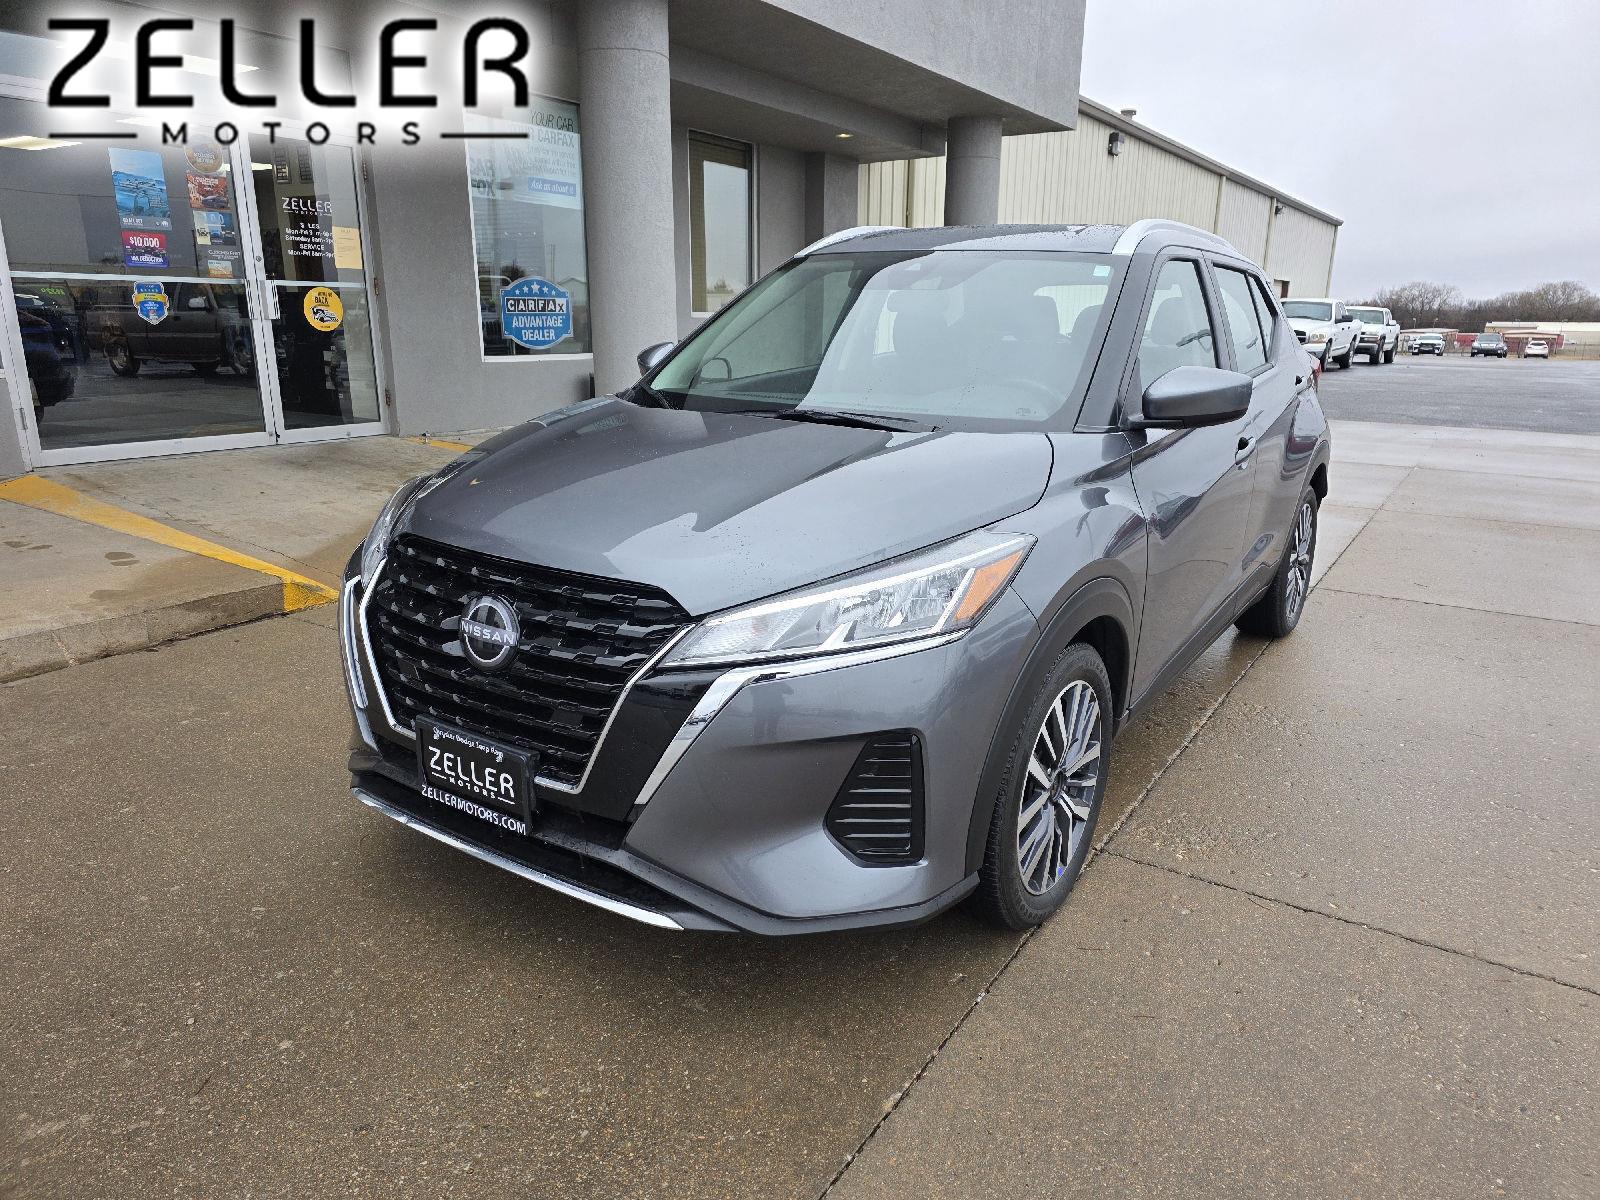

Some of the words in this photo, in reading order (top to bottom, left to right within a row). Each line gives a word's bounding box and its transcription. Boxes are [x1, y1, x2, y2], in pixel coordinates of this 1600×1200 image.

[556, 115, 574, 134] CAR
[537, 127, 575, 148] CARFAX
[281, 196, 333, 213] ZELLER
[299, 222, 320, 230] SLES
[129, 236, 160, 248] $10,000
[299, 243, 325, 251] SERVICE
[507, 299, 564, 313] CARFAX
[512, 315, 563, 328] ADVANTAGE
[521, 328, 556, 341] DEALER
[461, 620, 515, 645] NISSAN
[455, 734, 475, 748] Dodge
[428, 745, 515, 798] ZELLER
[449, 776, 496, 799] MOTORS
[421, 784, 527, 836] ZELLERMOTORS.COM
